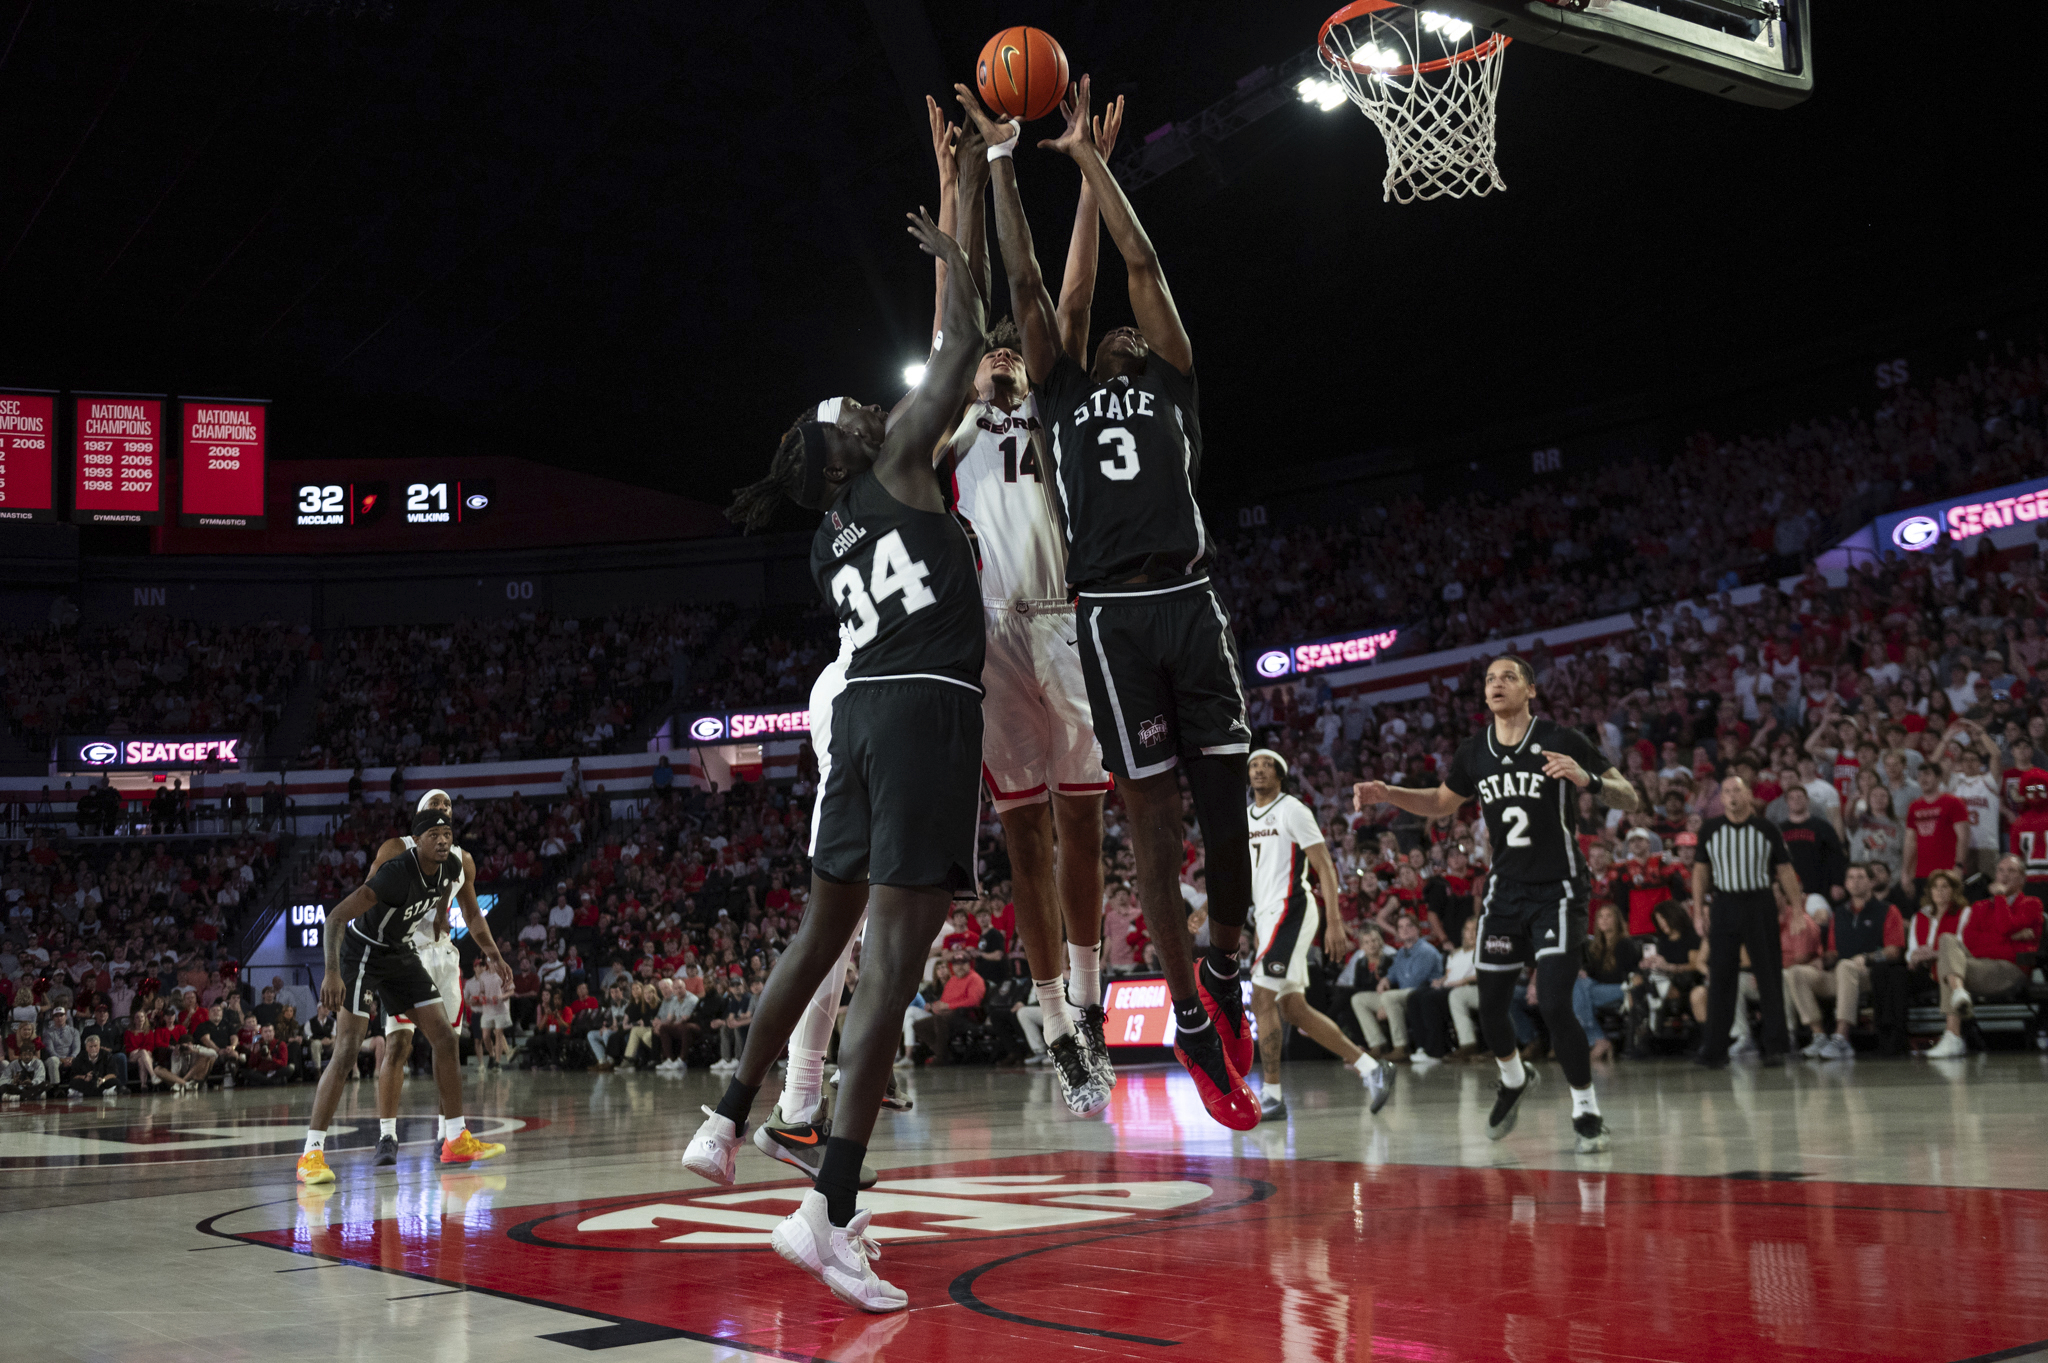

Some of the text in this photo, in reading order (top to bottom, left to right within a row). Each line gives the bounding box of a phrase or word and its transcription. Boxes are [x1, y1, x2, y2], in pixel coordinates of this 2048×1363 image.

[1876, 358, 1908, 390] SS
[0, 400, 21, 415] SEC
[91, 404, 147, 421] NATIONAL
[1074, 388, 1155, 426] STATE
[197, 409, 252, 426] NATIONAL
[85, 419, 152, 436] CHAMPIONS
[191, 424, 257, 441] CHAMPIONS
[12, 438, 46, 450] 2008
[83, 441, 153, 453] 1987 1999
[208, 446, 240, 457] 2008
[83, 454, 153, 467] 1989 2005
[999, 436, 1042, 483] 14
[1097, 426, 1141, 481] 3
[1533, 448, 1561, 474] RR
[83, 467, 153, 480] 1993 2006
[208, 459, 240, 470] 2009
[83, 480, 152, 493] 1998 2007
[298, 485, 344, 513] 32
[407, 483, 447, 511] 21
[93, 514, 141, 522] GYMNASTICS
[200, 518, 247, 526] GYMNASTICS
[297, 515, 344, 526] MCCLAIN
[407, 512, 450, 523] WILKINS
[832, 522, 868, 558] CHOL
[133, 587, 166, 606] NN
[831, 528, 938, 651] 34
[1477, 771, 1546, 805] STATE
[1502, 806, 1532, 847] 2
[1252, 843, 1261, 868] 7
[292, 904, 327, 926] UGA
[302, 928, 319, 947] 13
[1123, 1014, 1145, 1043] 13
